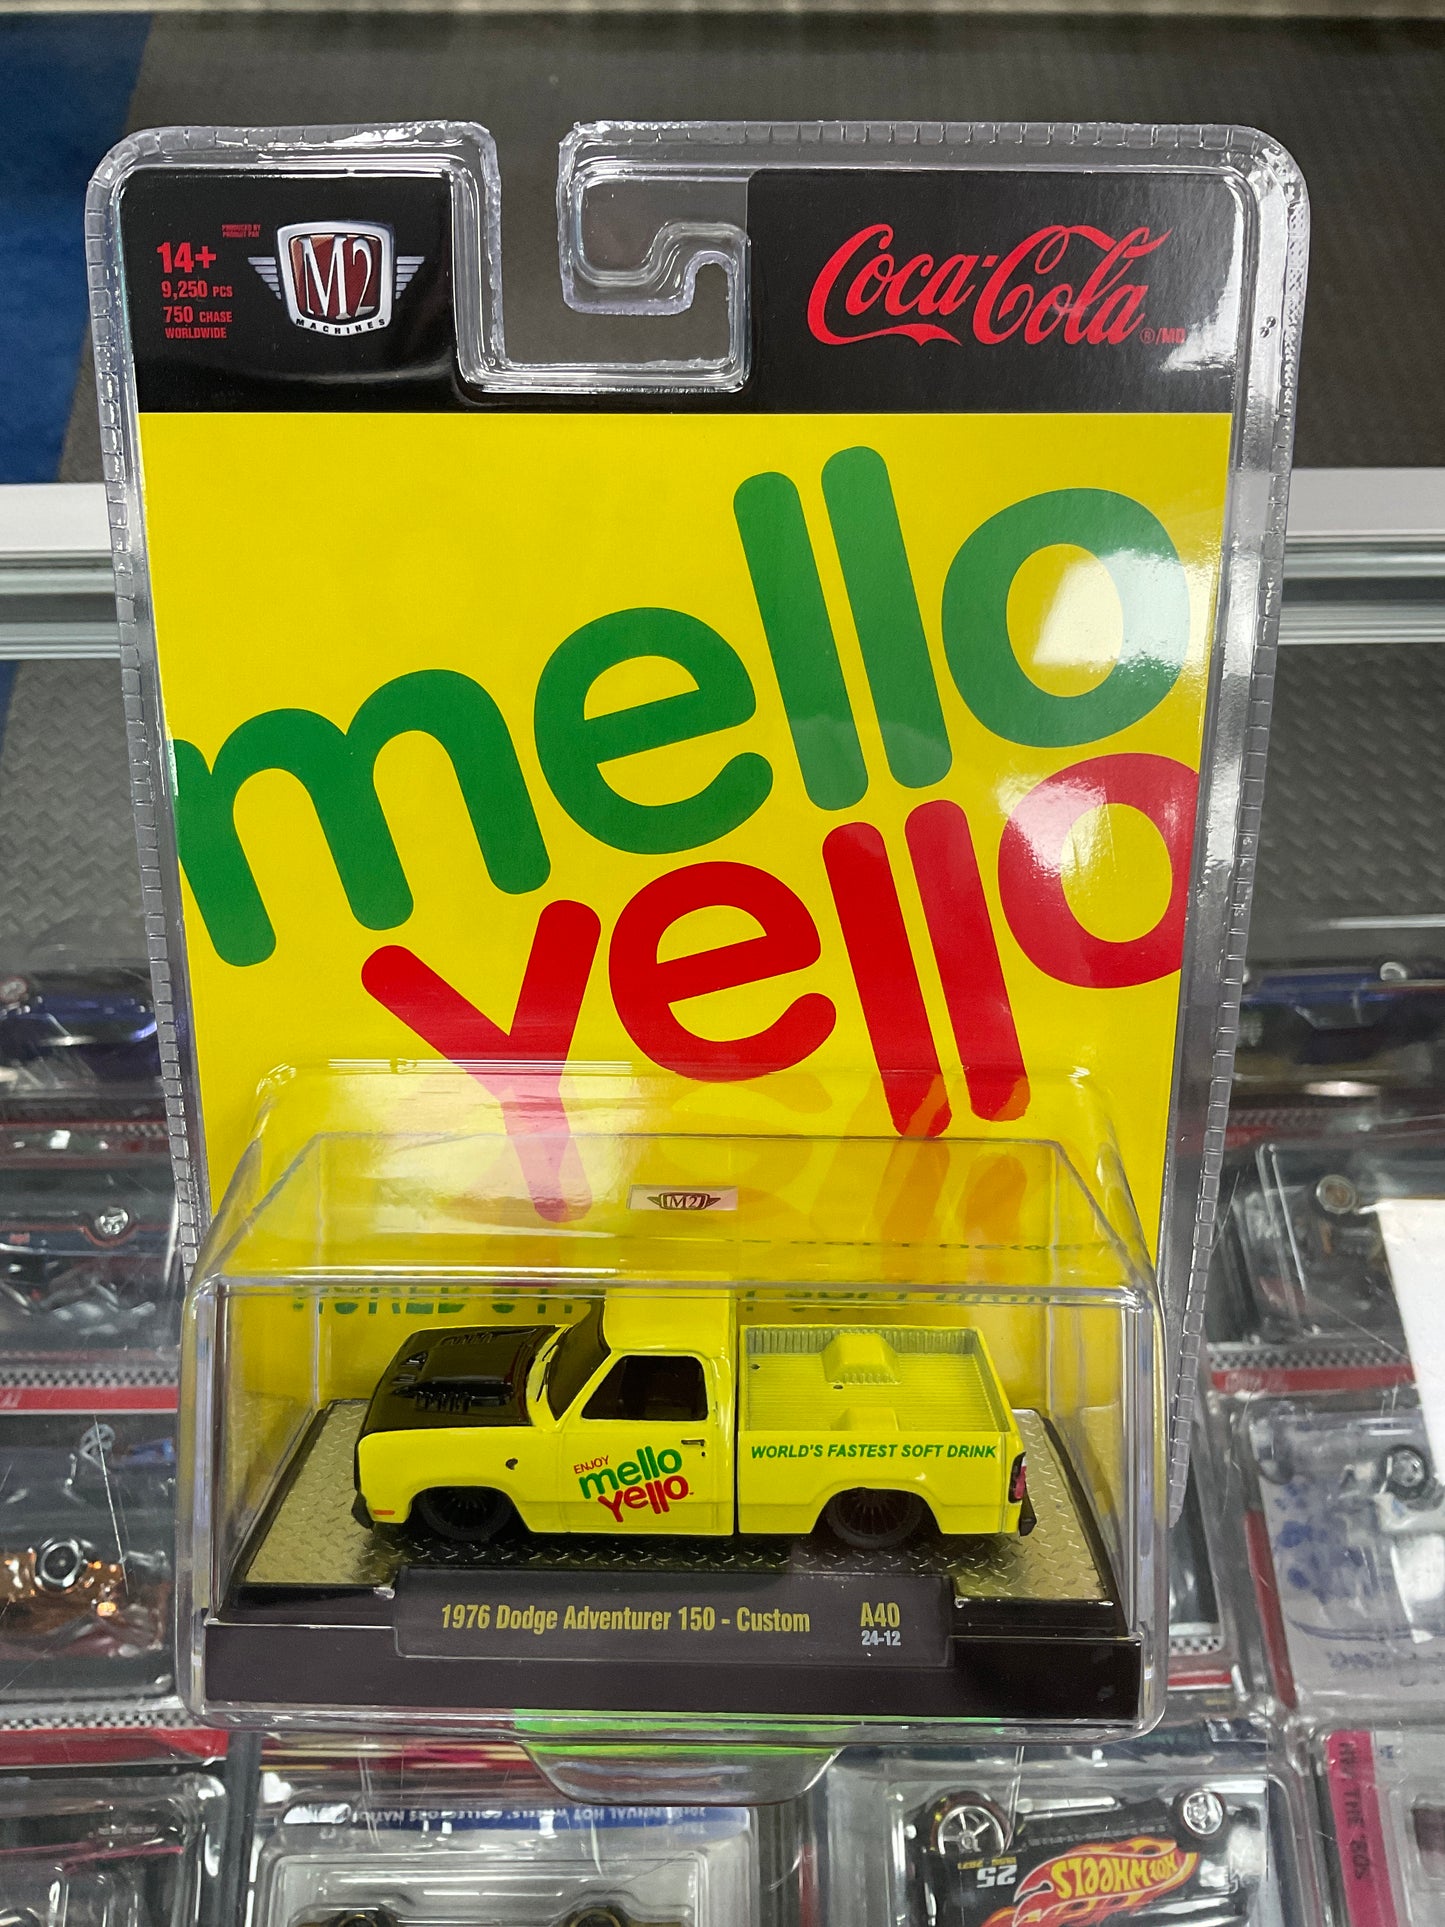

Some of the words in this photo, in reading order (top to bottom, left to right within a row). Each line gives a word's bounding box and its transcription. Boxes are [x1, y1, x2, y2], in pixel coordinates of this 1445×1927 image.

[156, 242, 217, 274] 14+
[161, 280, 208, 301] 9,250
[212, 286, 233, 298] PCS
[298, 236, 376, 320] M2
[807, 223, 1173, 347] Coca-Cola
[163, 306, 194, 323] 750
[199, 311, 233, 323] CHASE
[295, 318, 386, 335] MACHINES
[165, 327, 227, 339] WORLDWIDE
[176, 446, 1191, 967] mello
[751, 1444, 823, 1459] WORLD'S
[827, 1443, 898, 1458] FASTEST
[901, 1444, 944, 1458] SOFT
[946, 1444, 997, 1459] DRINK
[573, 1455, 609, 1475] ENJOY
[578, 1445, 683, 1500] mello
[441, 1603, 491, 1629] 1976
[496, 1604, 558, 1635] Dodge
[563, 1605, 672, 1631] Adventurer
[678, 1606, 716, 1632] 150
[736, 1606, 811, 1633] Custom
[860, 1602, 901, 1628] A40
[861, 1630, 902, 1646] 24-12
[976, 1864, 1018, 1889] 25
[1149, 1851, 1179, 1882] HOT
